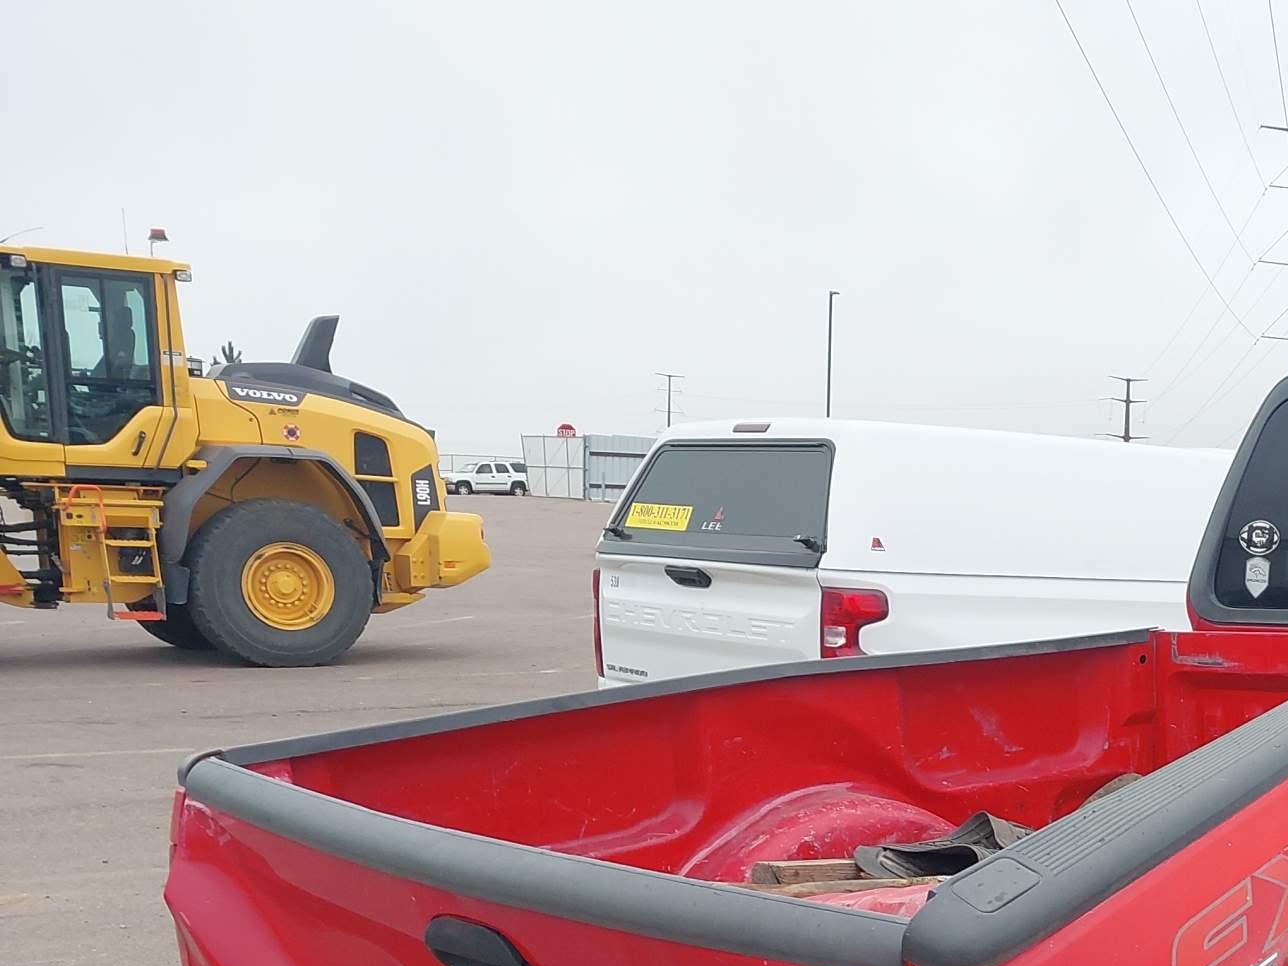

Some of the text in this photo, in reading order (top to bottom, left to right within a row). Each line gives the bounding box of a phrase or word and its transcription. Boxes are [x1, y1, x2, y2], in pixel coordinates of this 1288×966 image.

[231, 387, 299, 402] VOLVO
[557, 429, 576, 437] STOP
[415, 479, 431, 505] L90H
[630, 504, 691, 521] 1-800-311-3171
[606, 601, 795, 644] CHEVROLET
